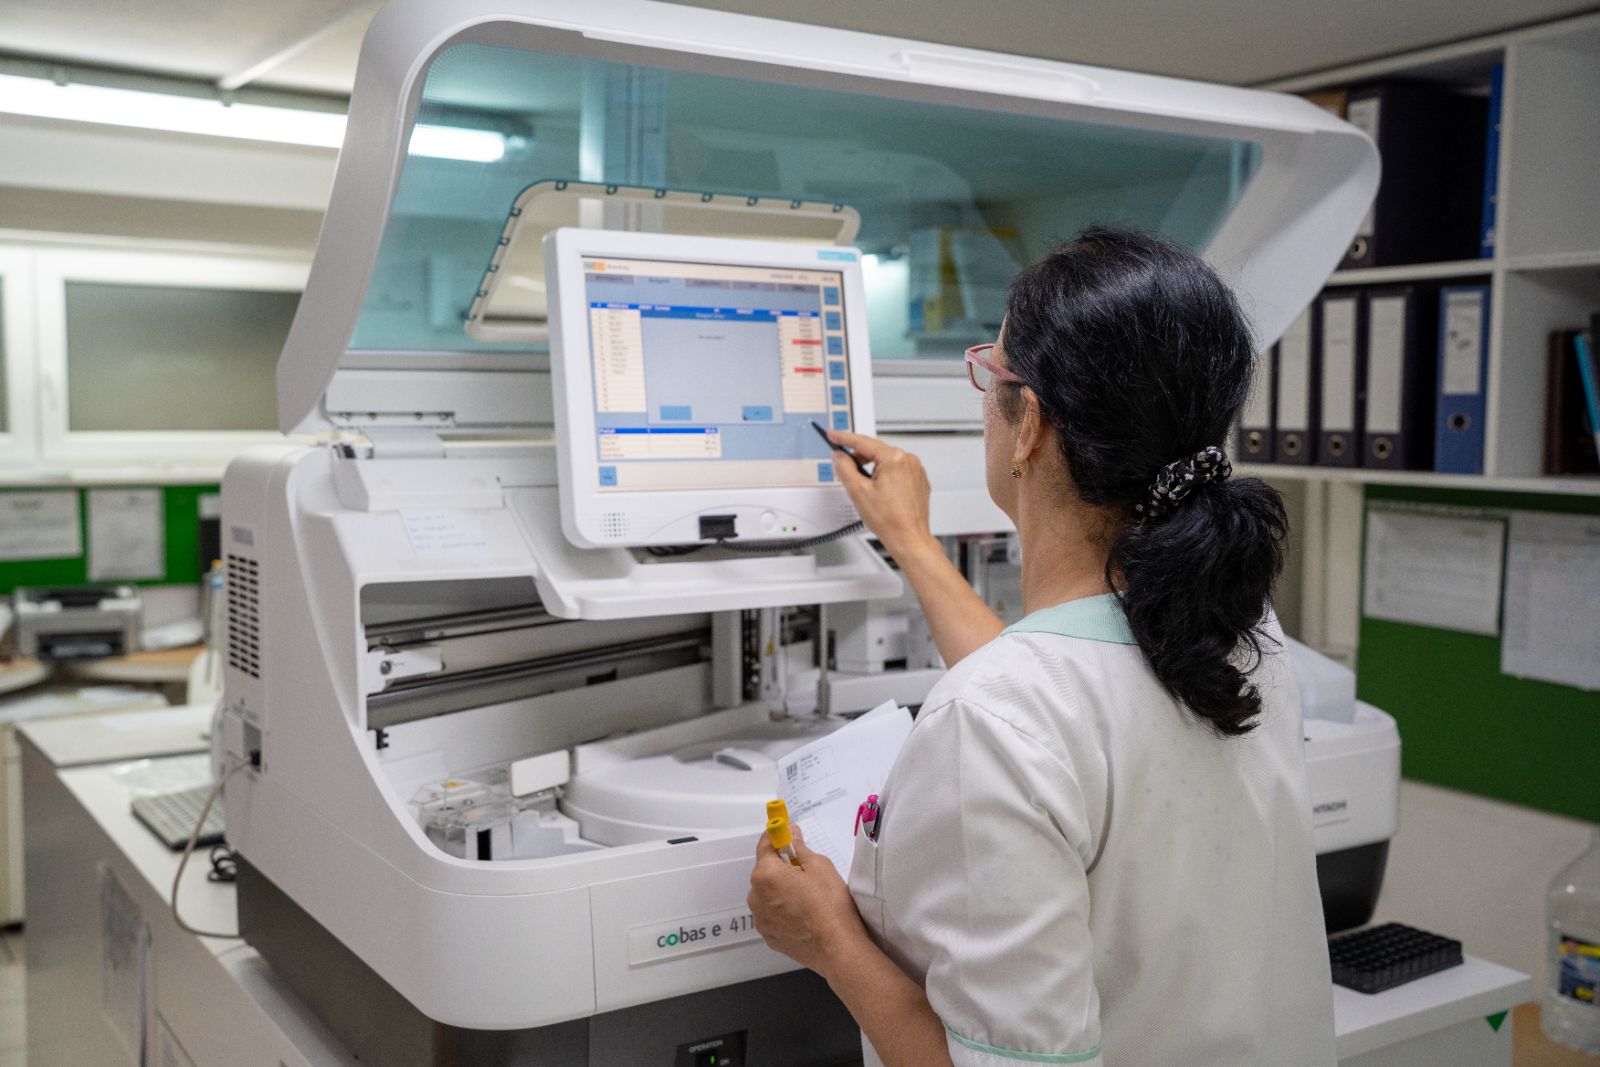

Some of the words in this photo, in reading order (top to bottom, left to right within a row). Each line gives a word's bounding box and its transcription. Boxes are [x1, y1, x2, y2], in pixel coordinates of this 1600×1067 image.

[657, 927, 706, 948] cobas
[711, 924, 721, 937] e
[688, 1039, 723, 1053] OPERATION
